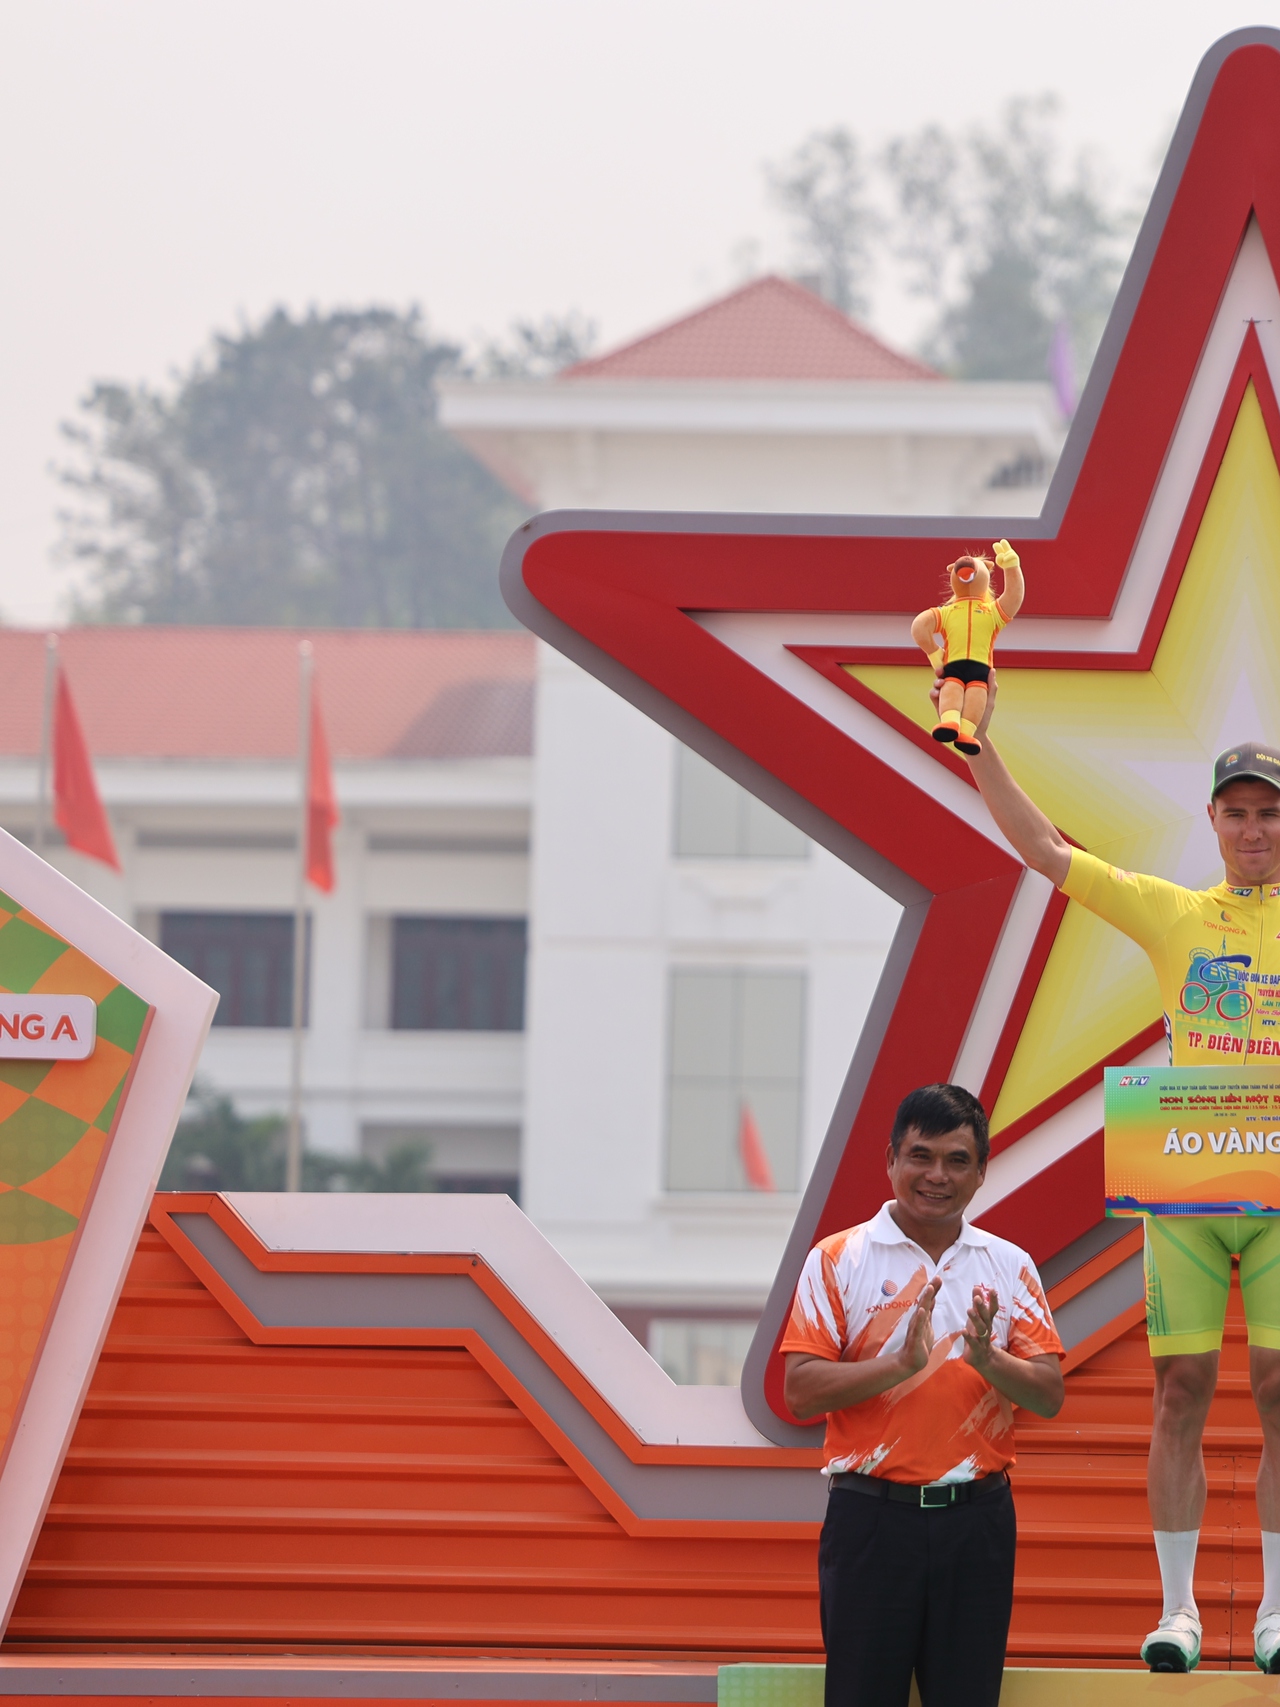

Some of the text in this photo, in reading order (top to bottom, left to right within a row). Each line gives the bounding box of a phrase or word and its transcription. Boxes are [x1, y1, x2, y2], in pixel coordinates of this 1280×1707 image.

[1203, 920, 1218, 930] TON
[1219, 925, 1240, 935] DONG
[1188, 1031, 1204, 1049] TP.
[1207, 1032, 1244, 1055] ĐIỆN
[1119, 1076, 1150, 1086] HTV
[1159, 1096, 1183, 1104] NON
[1187, 1094, 1217, 1104] SÔNG
[1163, 1127, 1203, 1154] ÁO
[866, 1303, 883, 1314] TON
[884, 1300, 912, 1310] DONG
